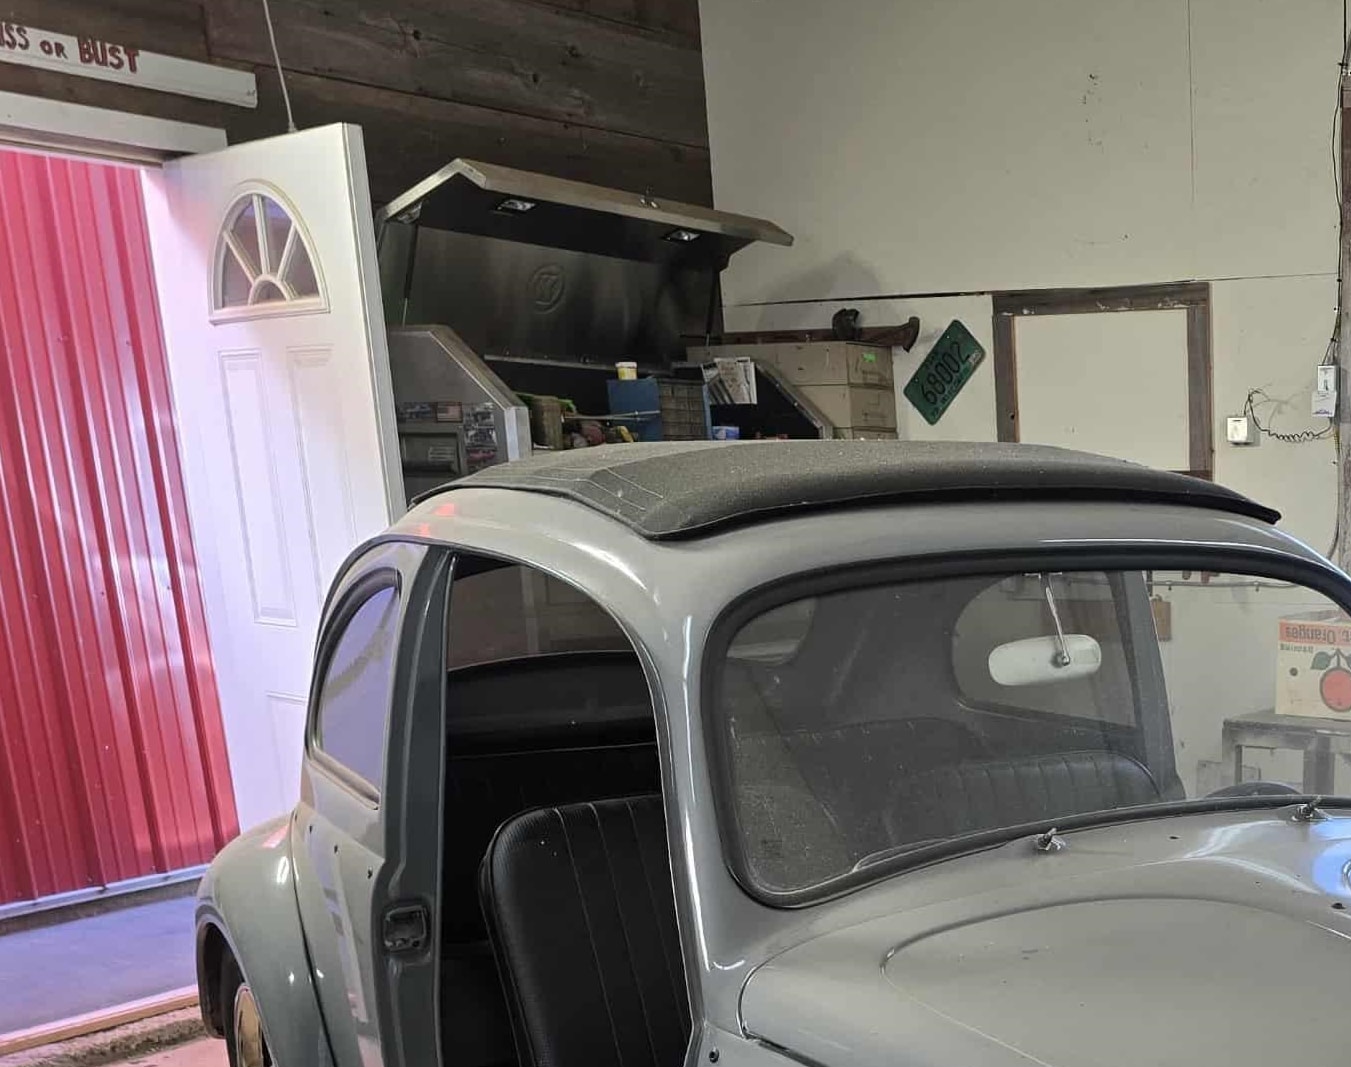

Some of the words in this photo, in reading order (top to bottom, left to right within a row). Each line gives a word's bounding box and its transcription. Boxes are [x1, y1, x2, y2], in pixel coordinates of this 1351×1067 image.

[40, 40, 68, 59] OR
[77, 35, 139, 74] BUST
[921, 341, 970, 405] 68002
[1285, 625, 1337, 645] Oranges
